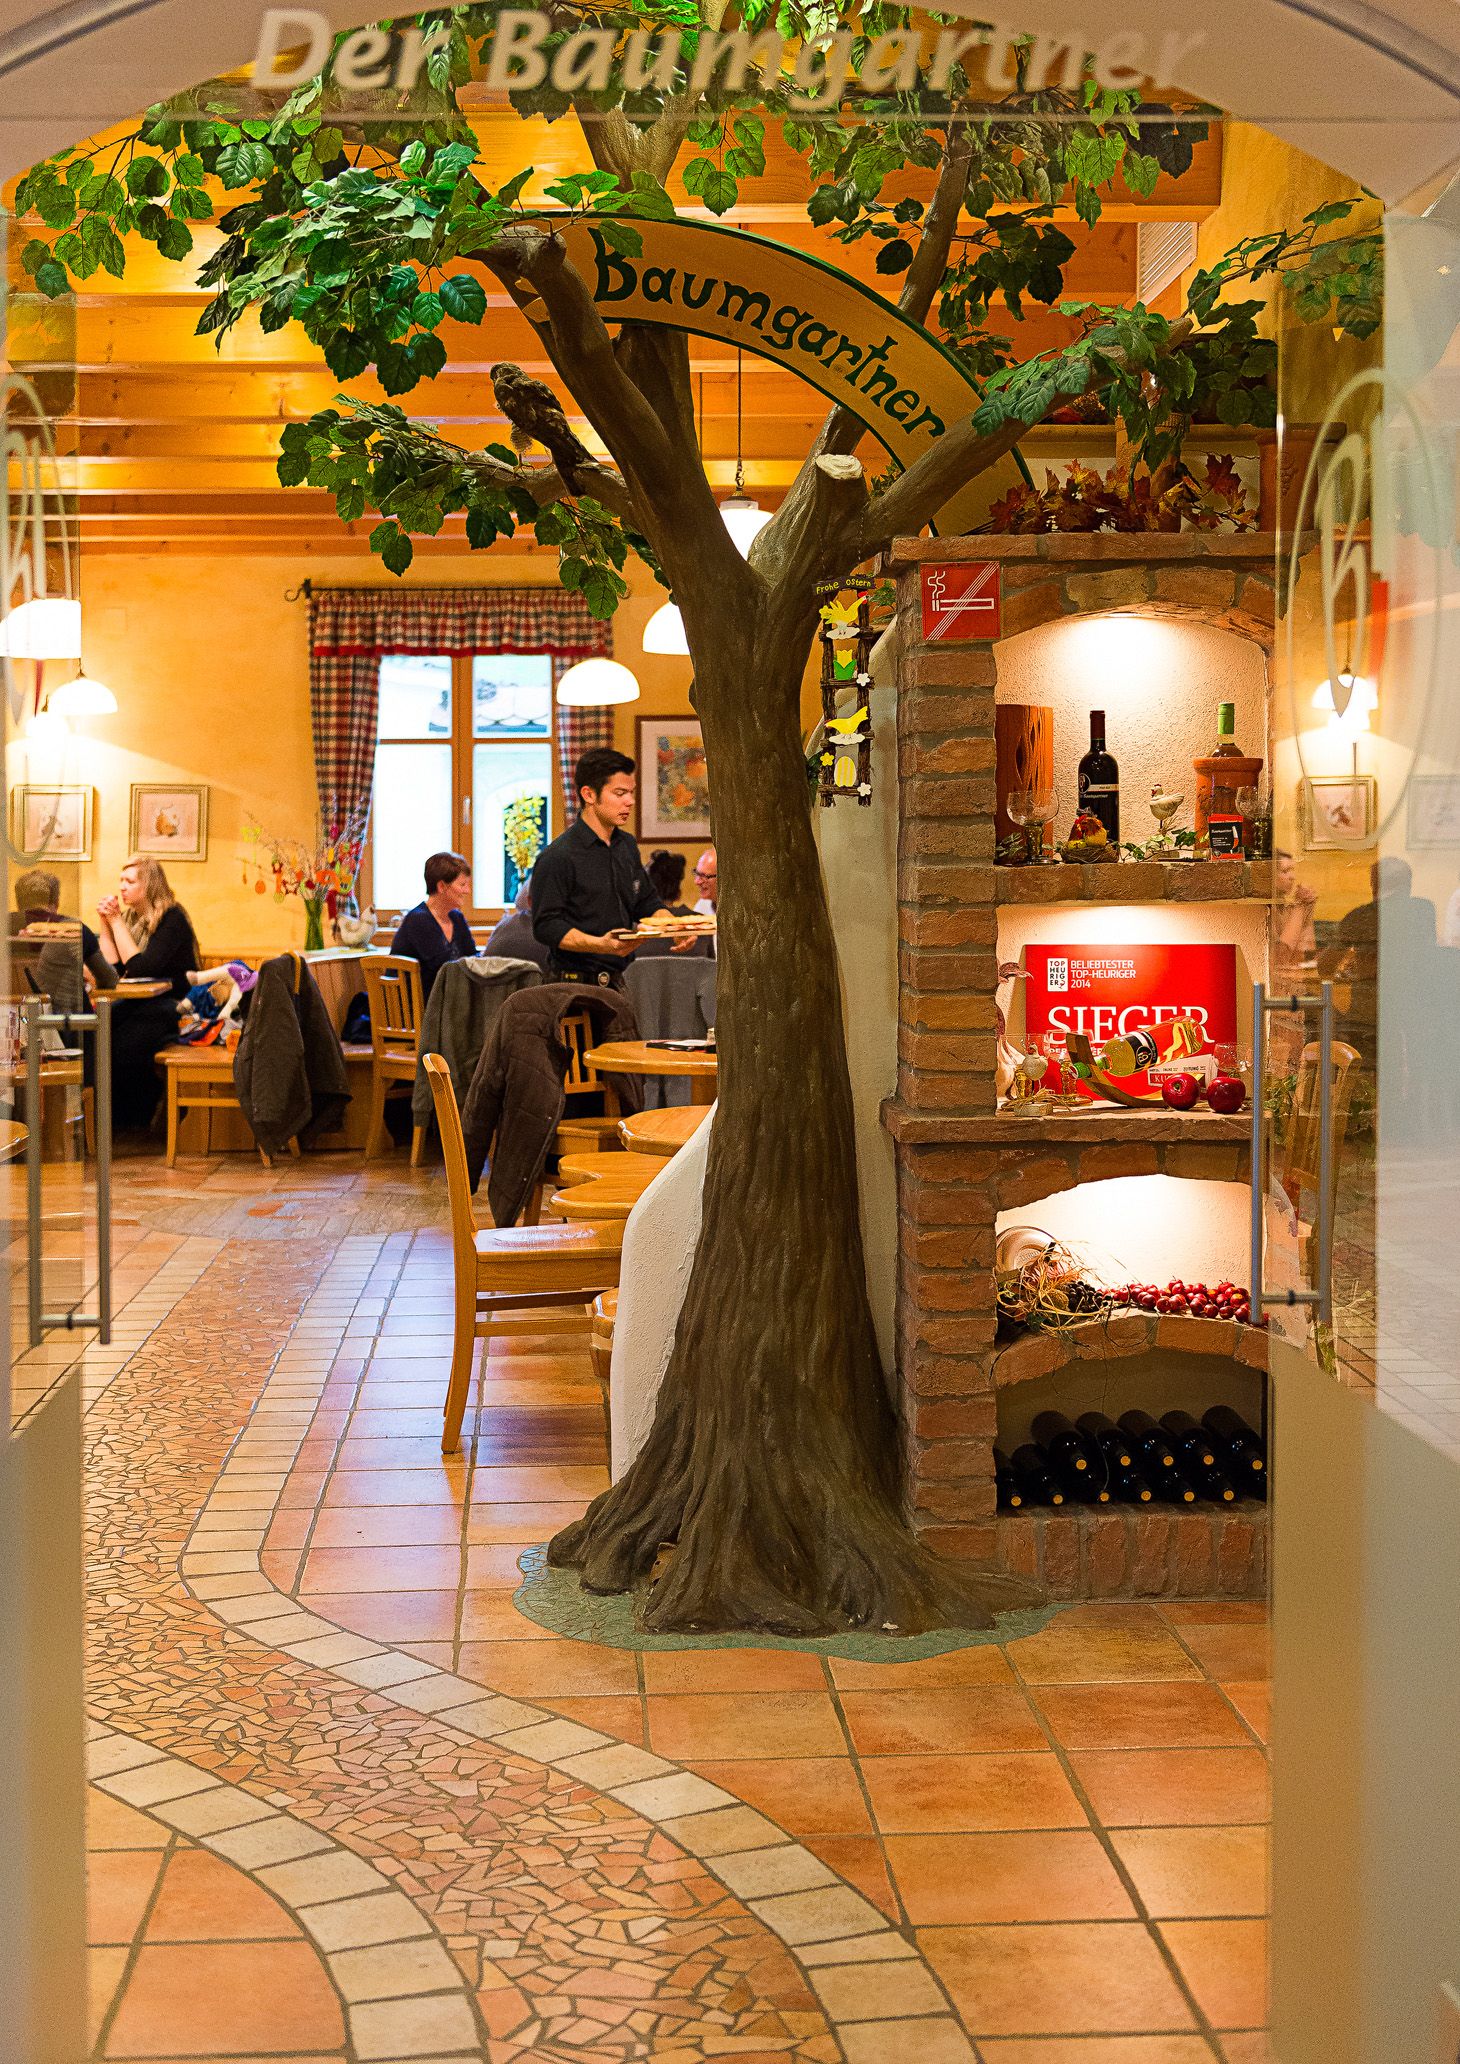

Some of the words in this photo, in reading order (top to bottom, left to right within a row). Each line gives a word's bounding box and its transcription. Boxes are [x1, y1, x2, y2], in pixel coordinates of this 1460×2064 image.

[250, 8, 452, 91] Der
[486, 8, 1206, 111] Baumgartner
[594, 226, 947, 438] Baumgartner
[816, 581, 840, 594] Frohe
[1070, 960, 1134, 969] BELIEBTESTER
[1070, 969, 1136, 979] TOP-HEURIGER
[1070, 979, 1091, 989] 2014
[1048, 1006, 1215, 1044] SIEGR
